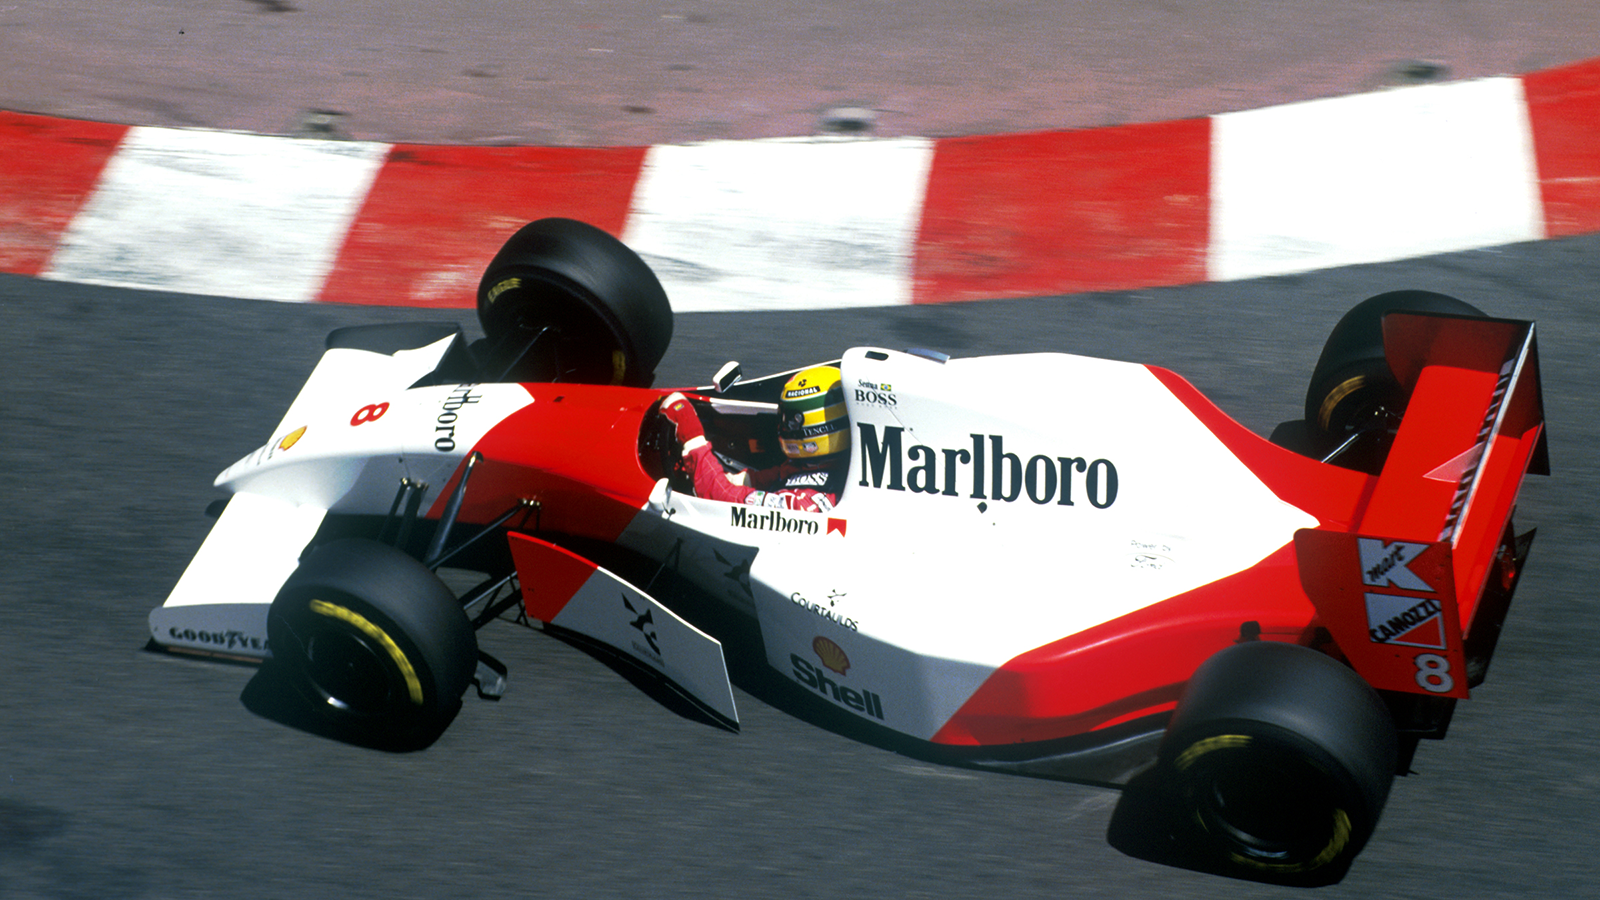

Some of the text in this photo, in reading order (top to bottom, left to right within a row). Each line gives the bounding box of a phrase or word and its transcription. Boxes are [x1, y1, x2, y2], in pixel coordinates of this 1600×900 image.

[350, 402, 390, 426] 8
[855, 389, 898, 406] BOSS
[857, 422, 1119, 509] Marlboro
[731, 506, 819, 535] Marlboro
[1369, 599, 1442, 643] CAMOZZI
[790, 653, 884, 720] Shell
[1414, 653, 1454, 693] 8
